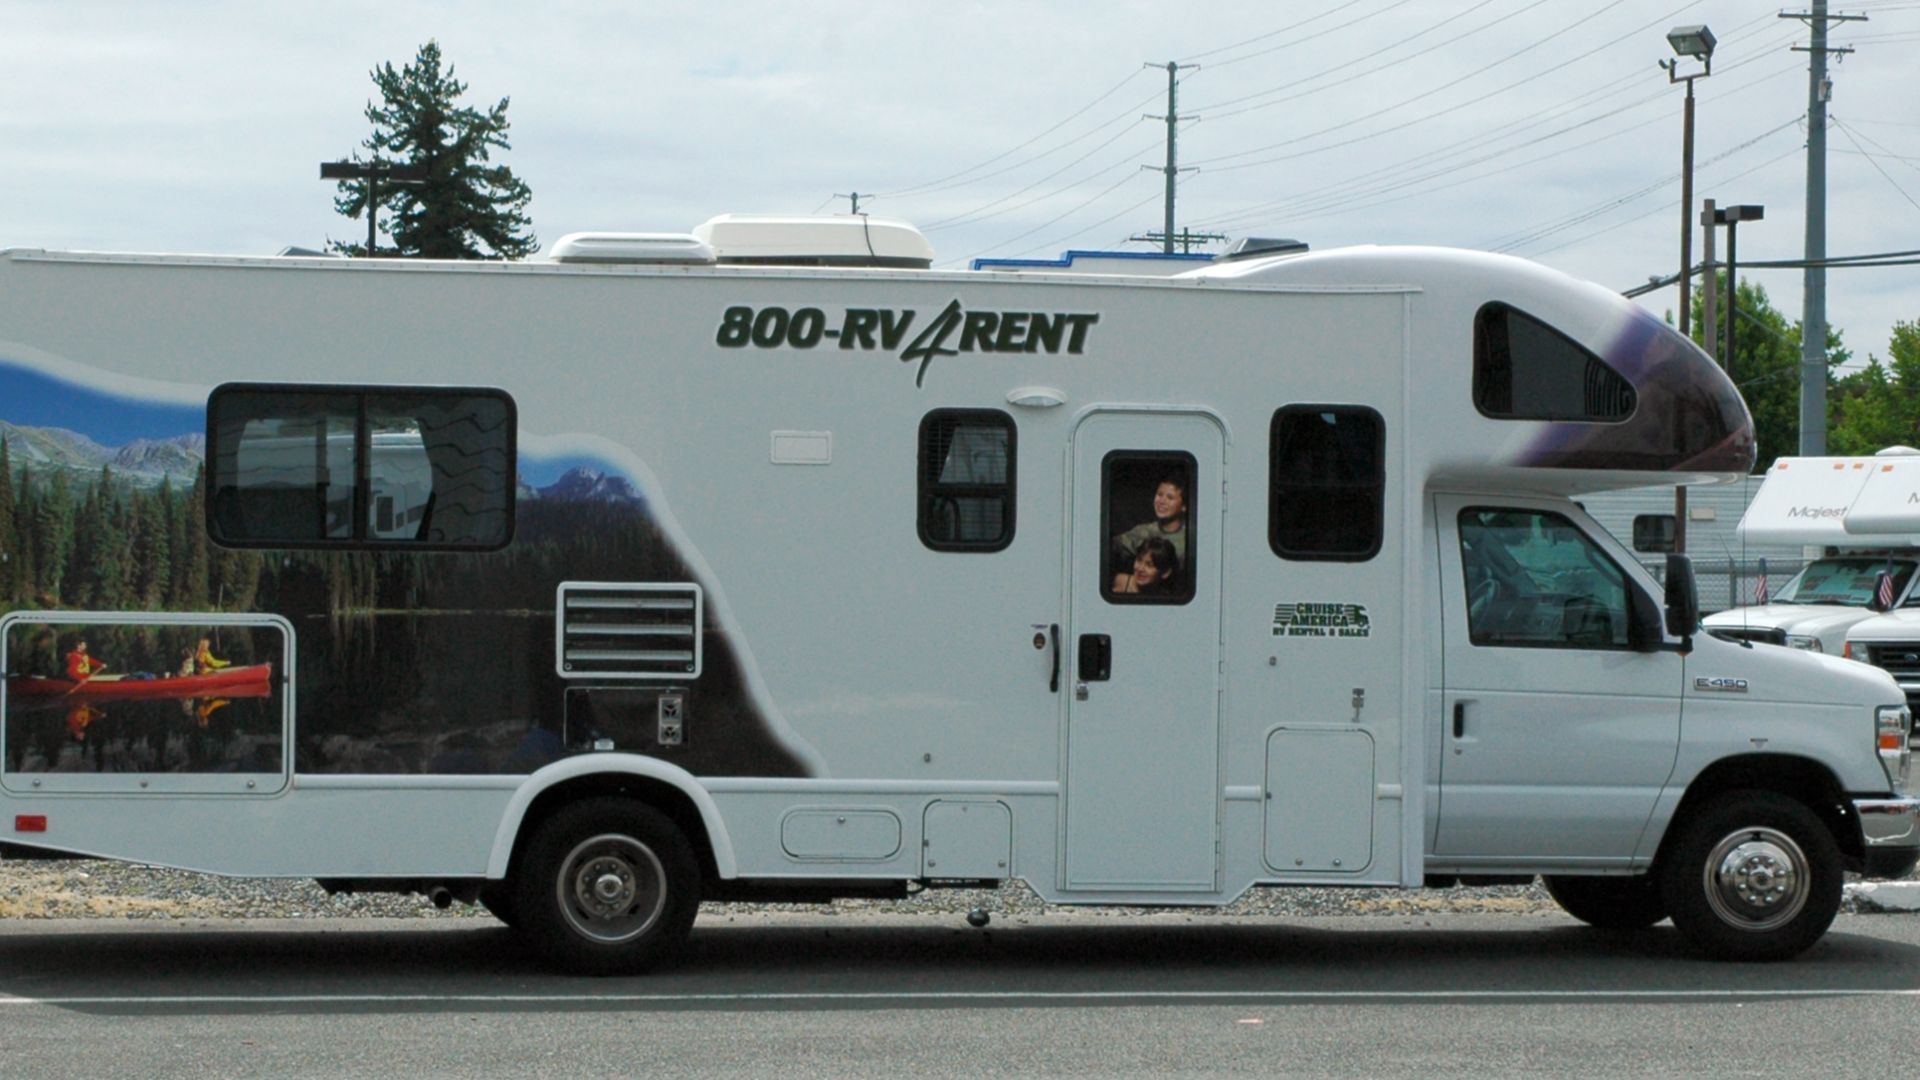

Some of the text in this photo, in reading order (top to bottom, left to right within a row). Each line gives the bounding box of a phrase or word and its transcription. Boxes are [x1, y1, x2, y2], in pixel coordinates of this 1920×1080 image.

[1296, 603, 1344, 615] CRUISE
[1291, 615, 1348, 626] AMERICA
[1273, 627, 1285, 636] RV
[1288, 627, 1326, 636] RENTAL
[1338, 628, 1369, 637] SALES
